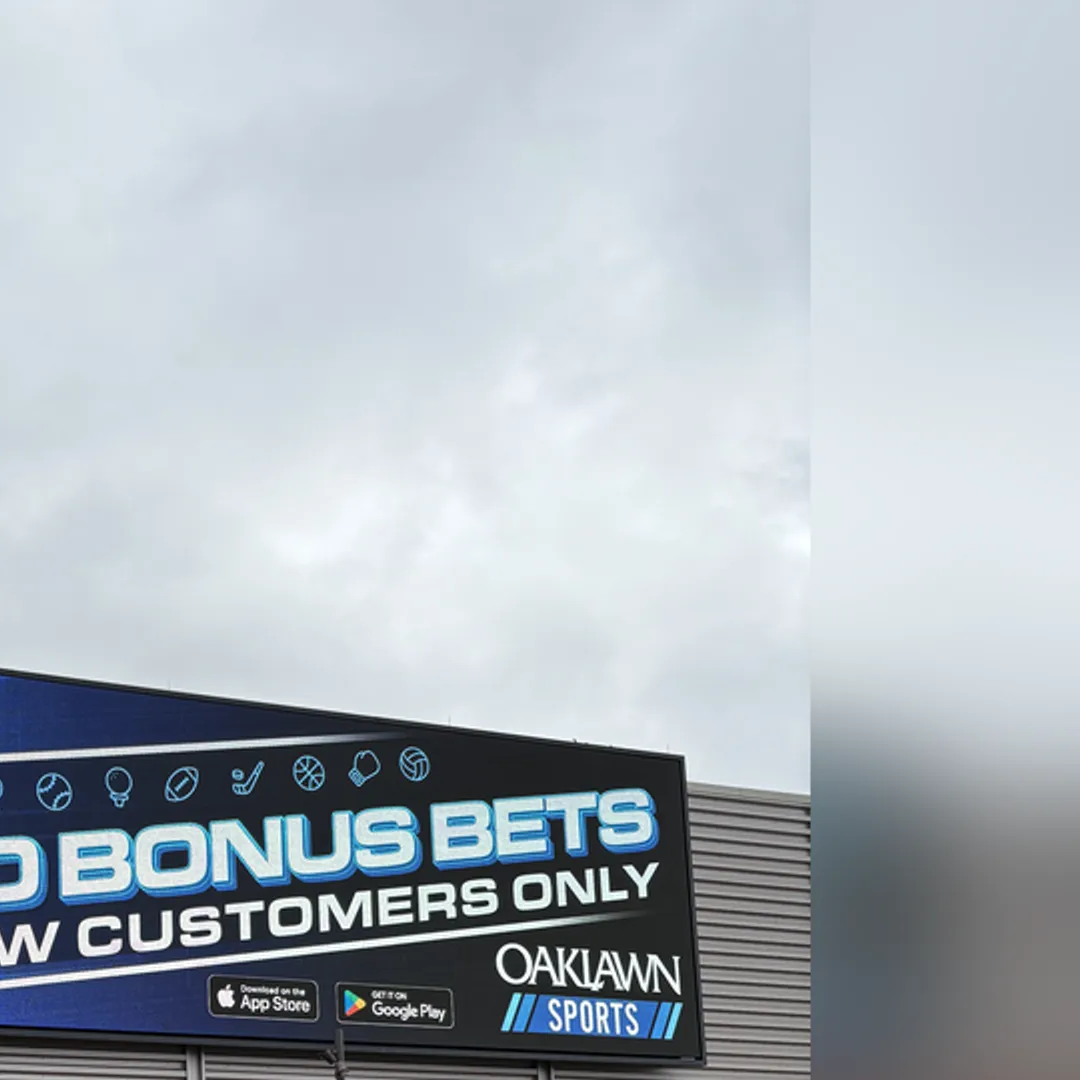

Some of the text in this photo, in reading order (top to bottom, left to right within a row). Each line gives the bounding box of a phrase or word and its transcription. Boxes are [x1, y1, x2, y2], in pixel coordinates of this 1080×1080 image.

[58, 806, 421, 903] BONUS
[430, 788, 659, 870] BETS
[77, 877, 498, 958] CUSTOMERS
[513, 862, 659, 911] ONLY
[495, 942, 682, 996] OAKLAWN
[240, 984, 279, 995] Download
[292, 987, 306, 996] the
[240, 994, 311, 1013] App Store
[371, 990, 386, 999] GET
[394, 992, 407, 1000] ON
[371, 1001, 447, 1022] Google Play
[547, 998, 640, 1036] SPORTS
